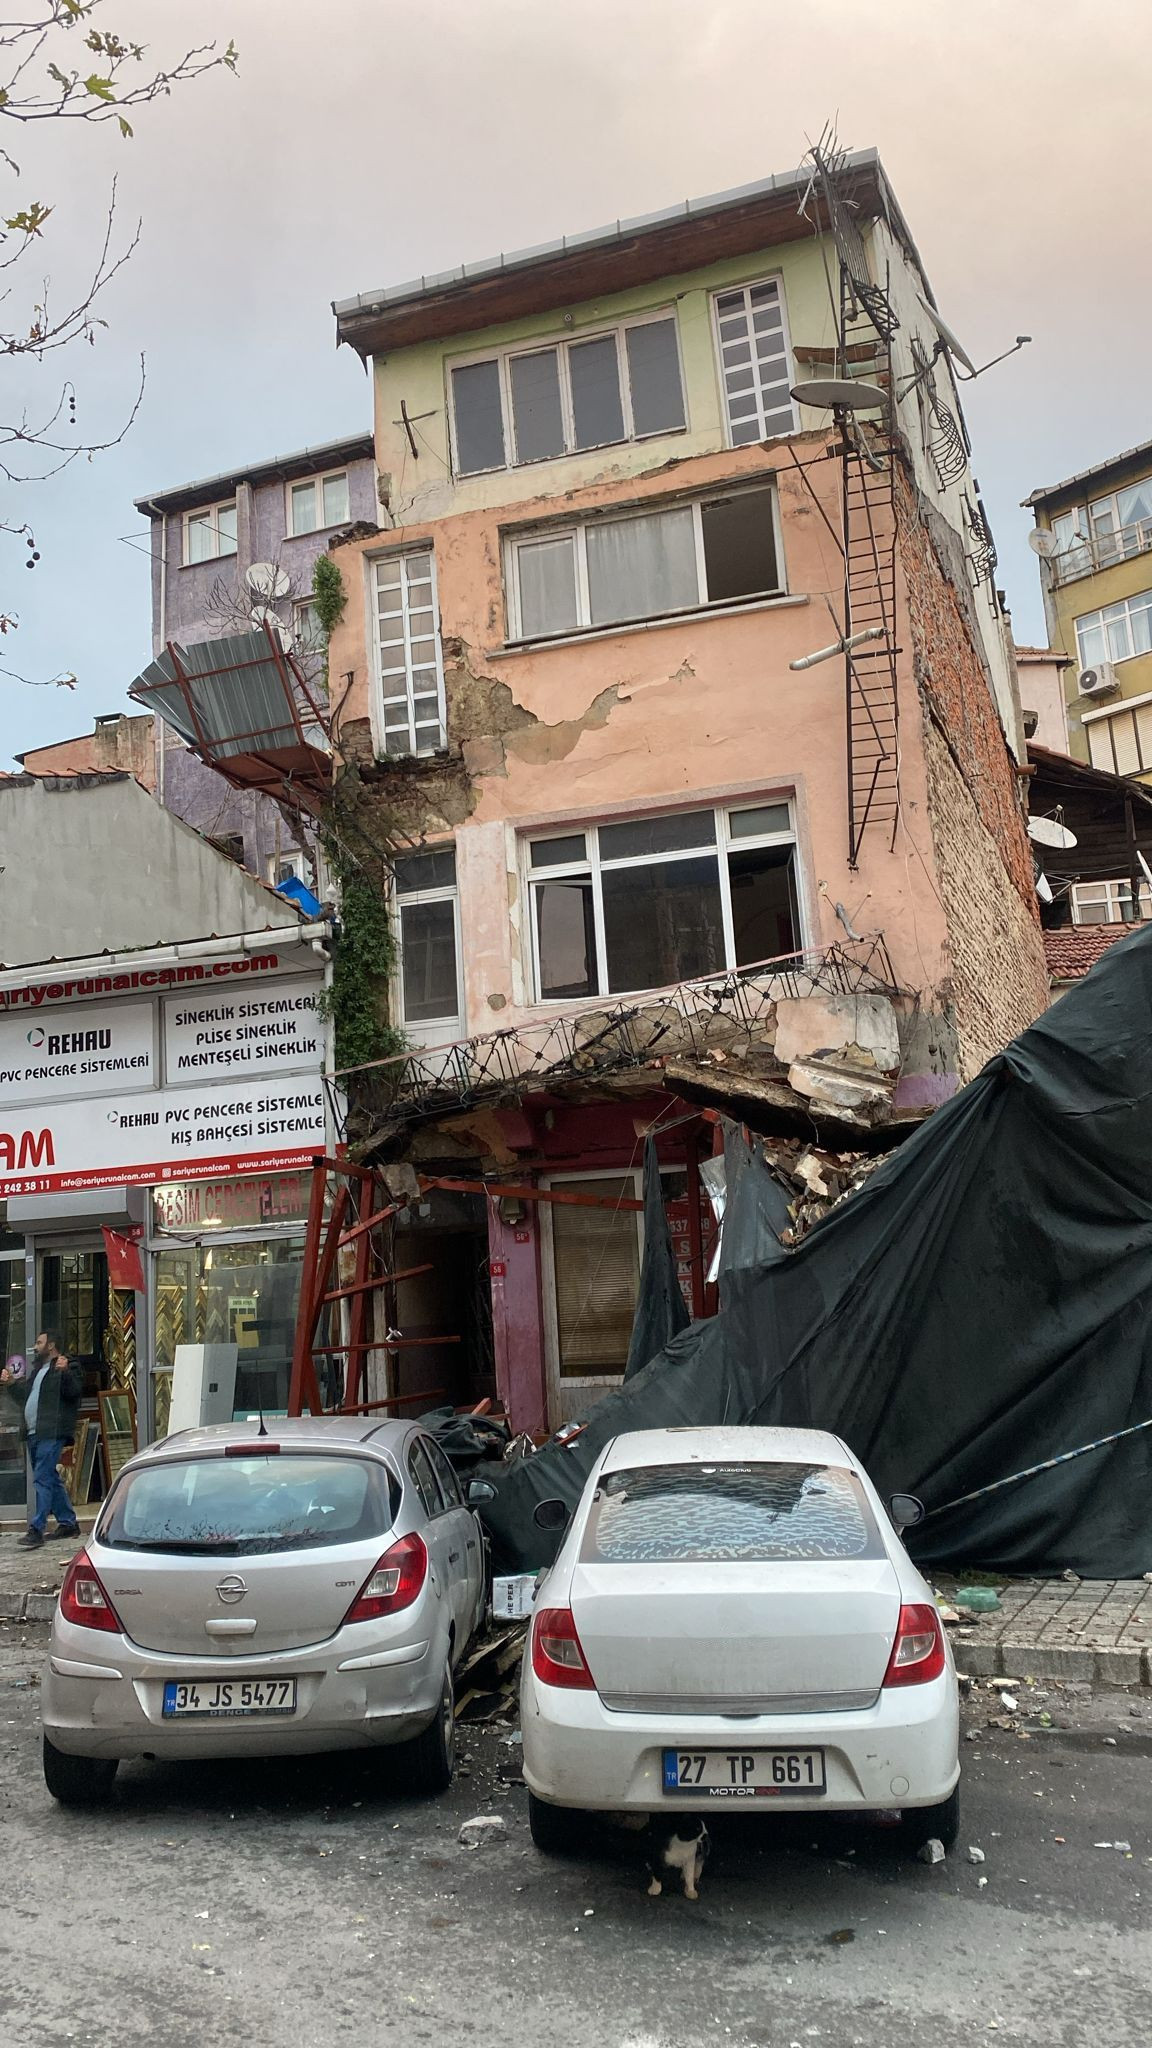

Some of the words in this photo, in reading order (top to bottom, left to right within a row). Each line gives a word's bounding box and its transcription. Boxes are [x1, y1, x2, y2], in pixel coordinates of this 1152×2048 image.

[175, 1002, 234, 1026] SİNEKLİK
[239, 993, 316, 1018] SİSTEMLERİ
[48, 1029, 111, 1055] REHAU
[196, 1028, 231, 1046] PLİSE
[236, 1019, 296, 1041] SİNEKLİK
[178, 1044, 250, 1068] MENTEŞELİ
[256, 1037, 316, 1059] SİNEKLİK
[0, 1070, 21, 1083] PVC
[25, 1063, 77, 1080] PENCERE
[80, 1052, 149, 1074] SİSTEMLERİ
[120, 1112, 159, 1128] REHAU
[165, 1108, 189, 1123] PVC
[193, 1101, 252, 1120] PENCERE
[171, 1130, 192, 1146] KIŞ
[197, 1119, 252, 1142] BAHÇESİ
[4, 1182, 22, 1194] 242
[24, 1181, 37, 1192] 38
[40, 1179, 50, 1190] 11
[60, 1171, 156, 1187] info@sariyerunalcam.com
[172, 1165, 231, 1177] sariyerunalcam
[166, 1699, 176, 1707] TR
[177, 1685, 201, 1709] 34
[209, 1684, 233, 1708] JS
[241, 1682, 290, 1706] 5477
[667, 1771, 677, 1781] TR
[679, 1755, 707, 1784] 27
[726, 1755, 755, 1784] TP
[772, 1755, 814, 1784] 661
